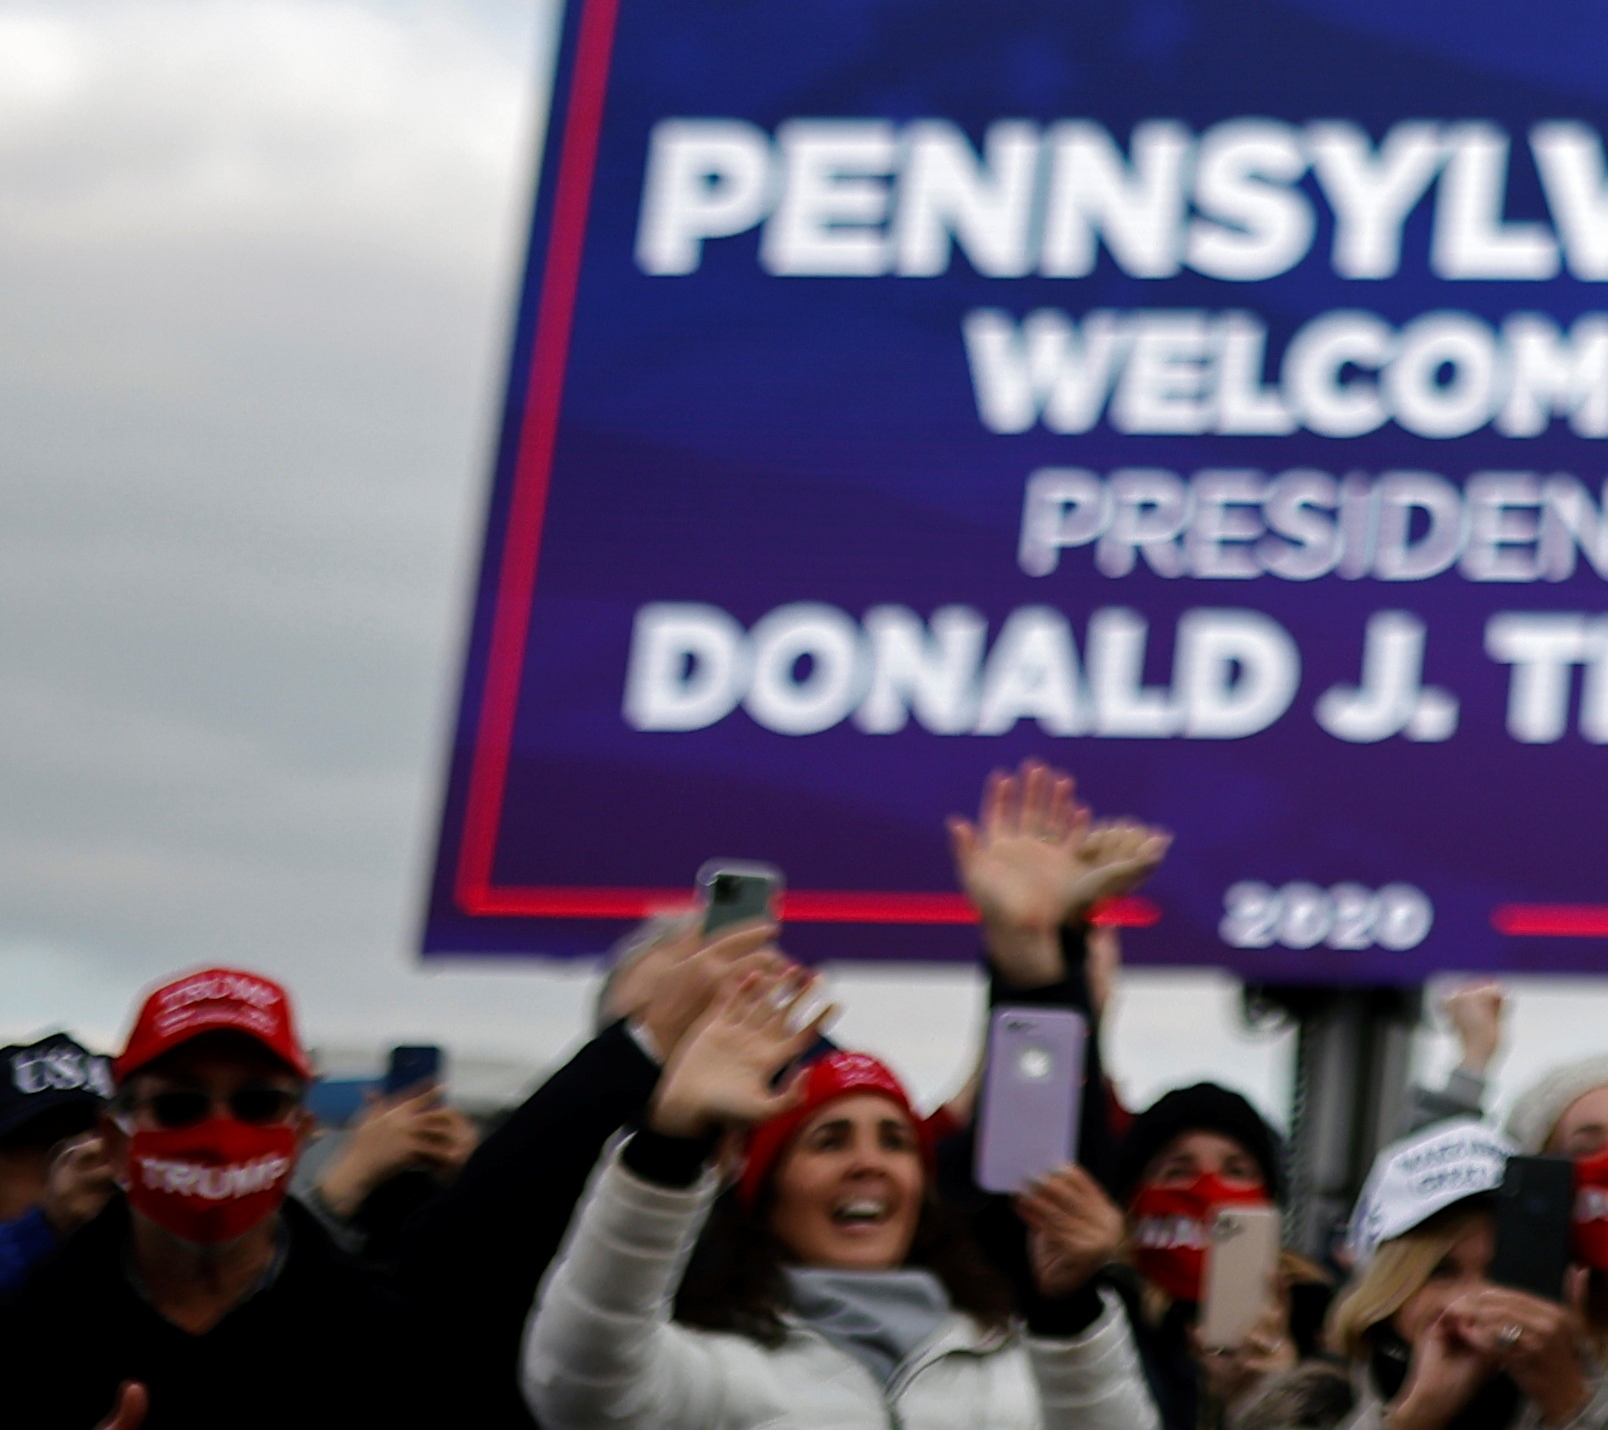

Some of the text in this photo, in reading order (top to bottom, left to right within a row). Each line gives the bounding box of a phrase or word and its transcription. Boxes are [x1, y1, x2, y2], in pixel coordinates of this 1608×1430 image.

[626, 606, 1297, 737] DONALD
[1318, 613, 1456, 740] J.
[1222, 883, 1431, 949] 2020
[141, 1154, 288, 1198] TRUMP
